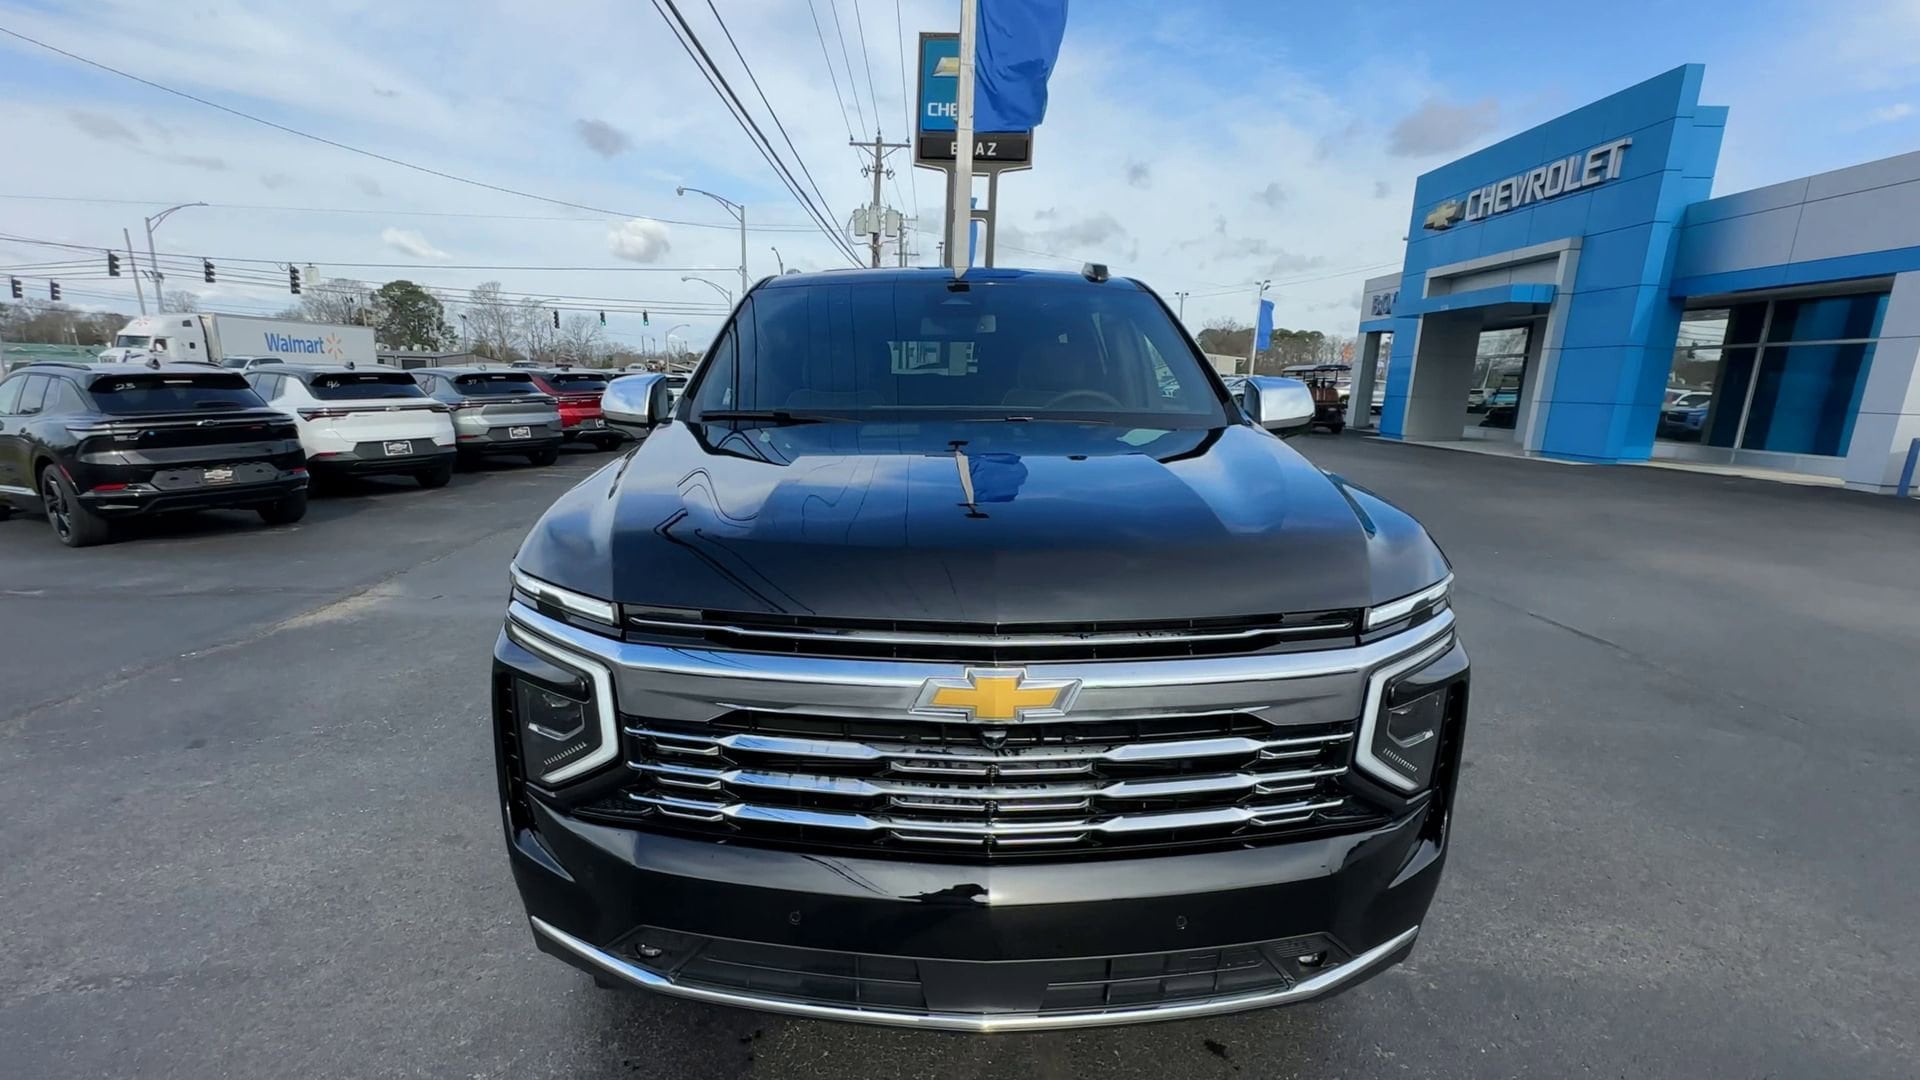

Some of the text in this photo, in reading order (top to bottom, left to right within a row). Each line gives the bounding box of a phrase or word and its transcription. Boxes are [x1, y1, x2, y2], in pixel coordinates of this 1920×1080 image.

[951, 142, 997, 156] BAZ
[1465, 137, 1632, 221] CHEVROLET
[264, 332, 325, 354] Walmart
